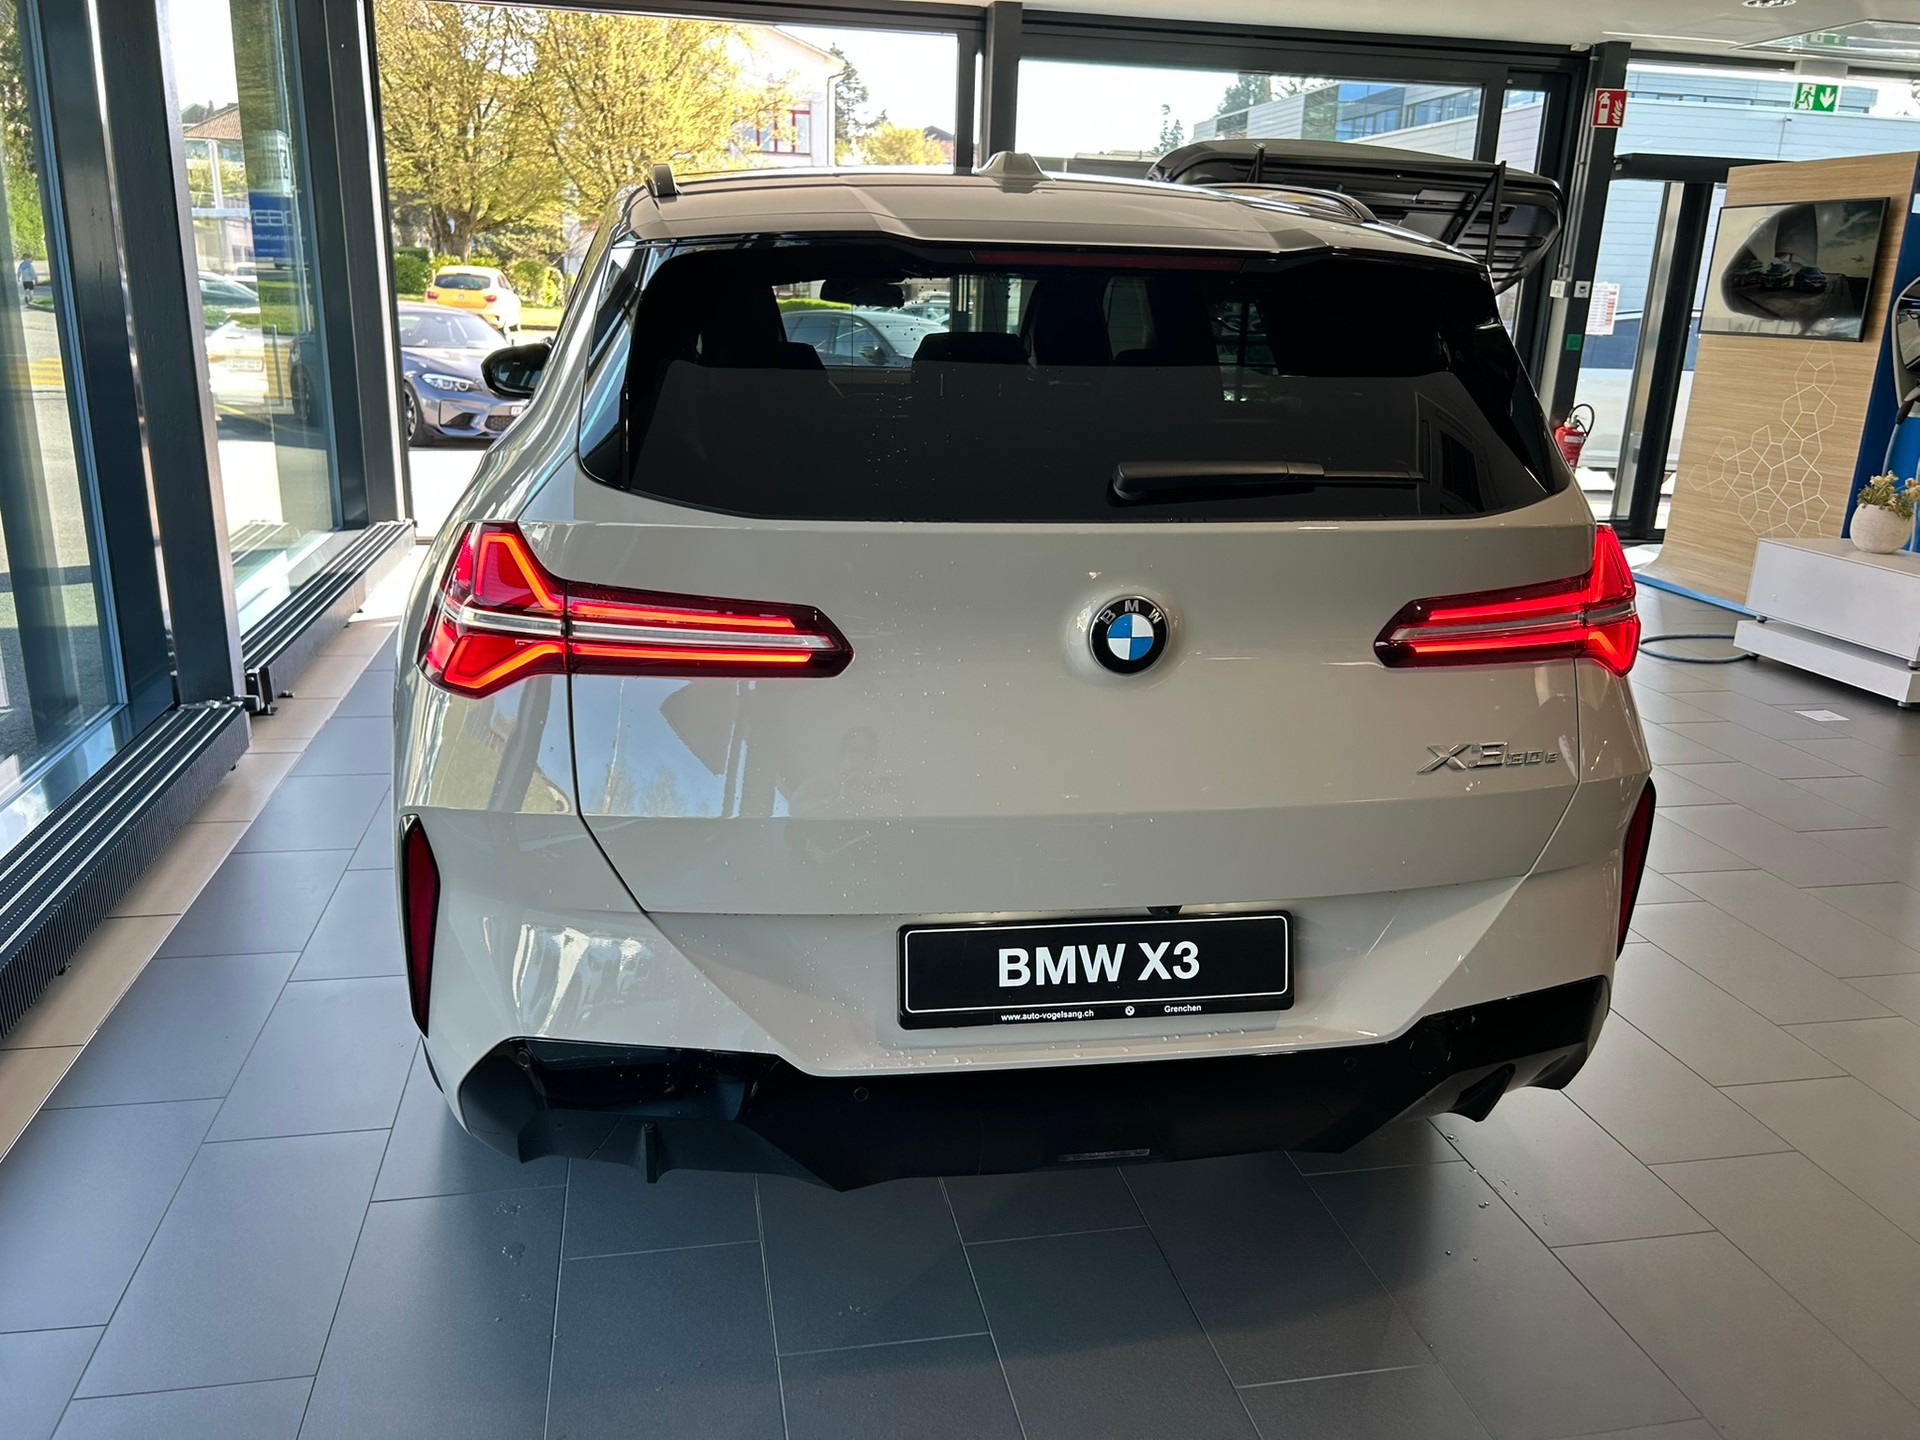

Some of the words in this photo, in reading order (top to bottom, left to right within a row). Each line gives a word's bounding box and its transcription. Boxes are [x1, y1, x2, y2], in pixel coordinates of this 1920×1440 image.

[1100, 600, 1162, 625] BMW
[1417, 741, 1508, 775] X3
[999, 943, 1126, 987] BMW
[1137, 941, 1200, 981] X3
[1001, 1009, 1094, 1021] www.auto-vogelsang.ch
[1164, 1004, 1202, 1013] Grenchen
